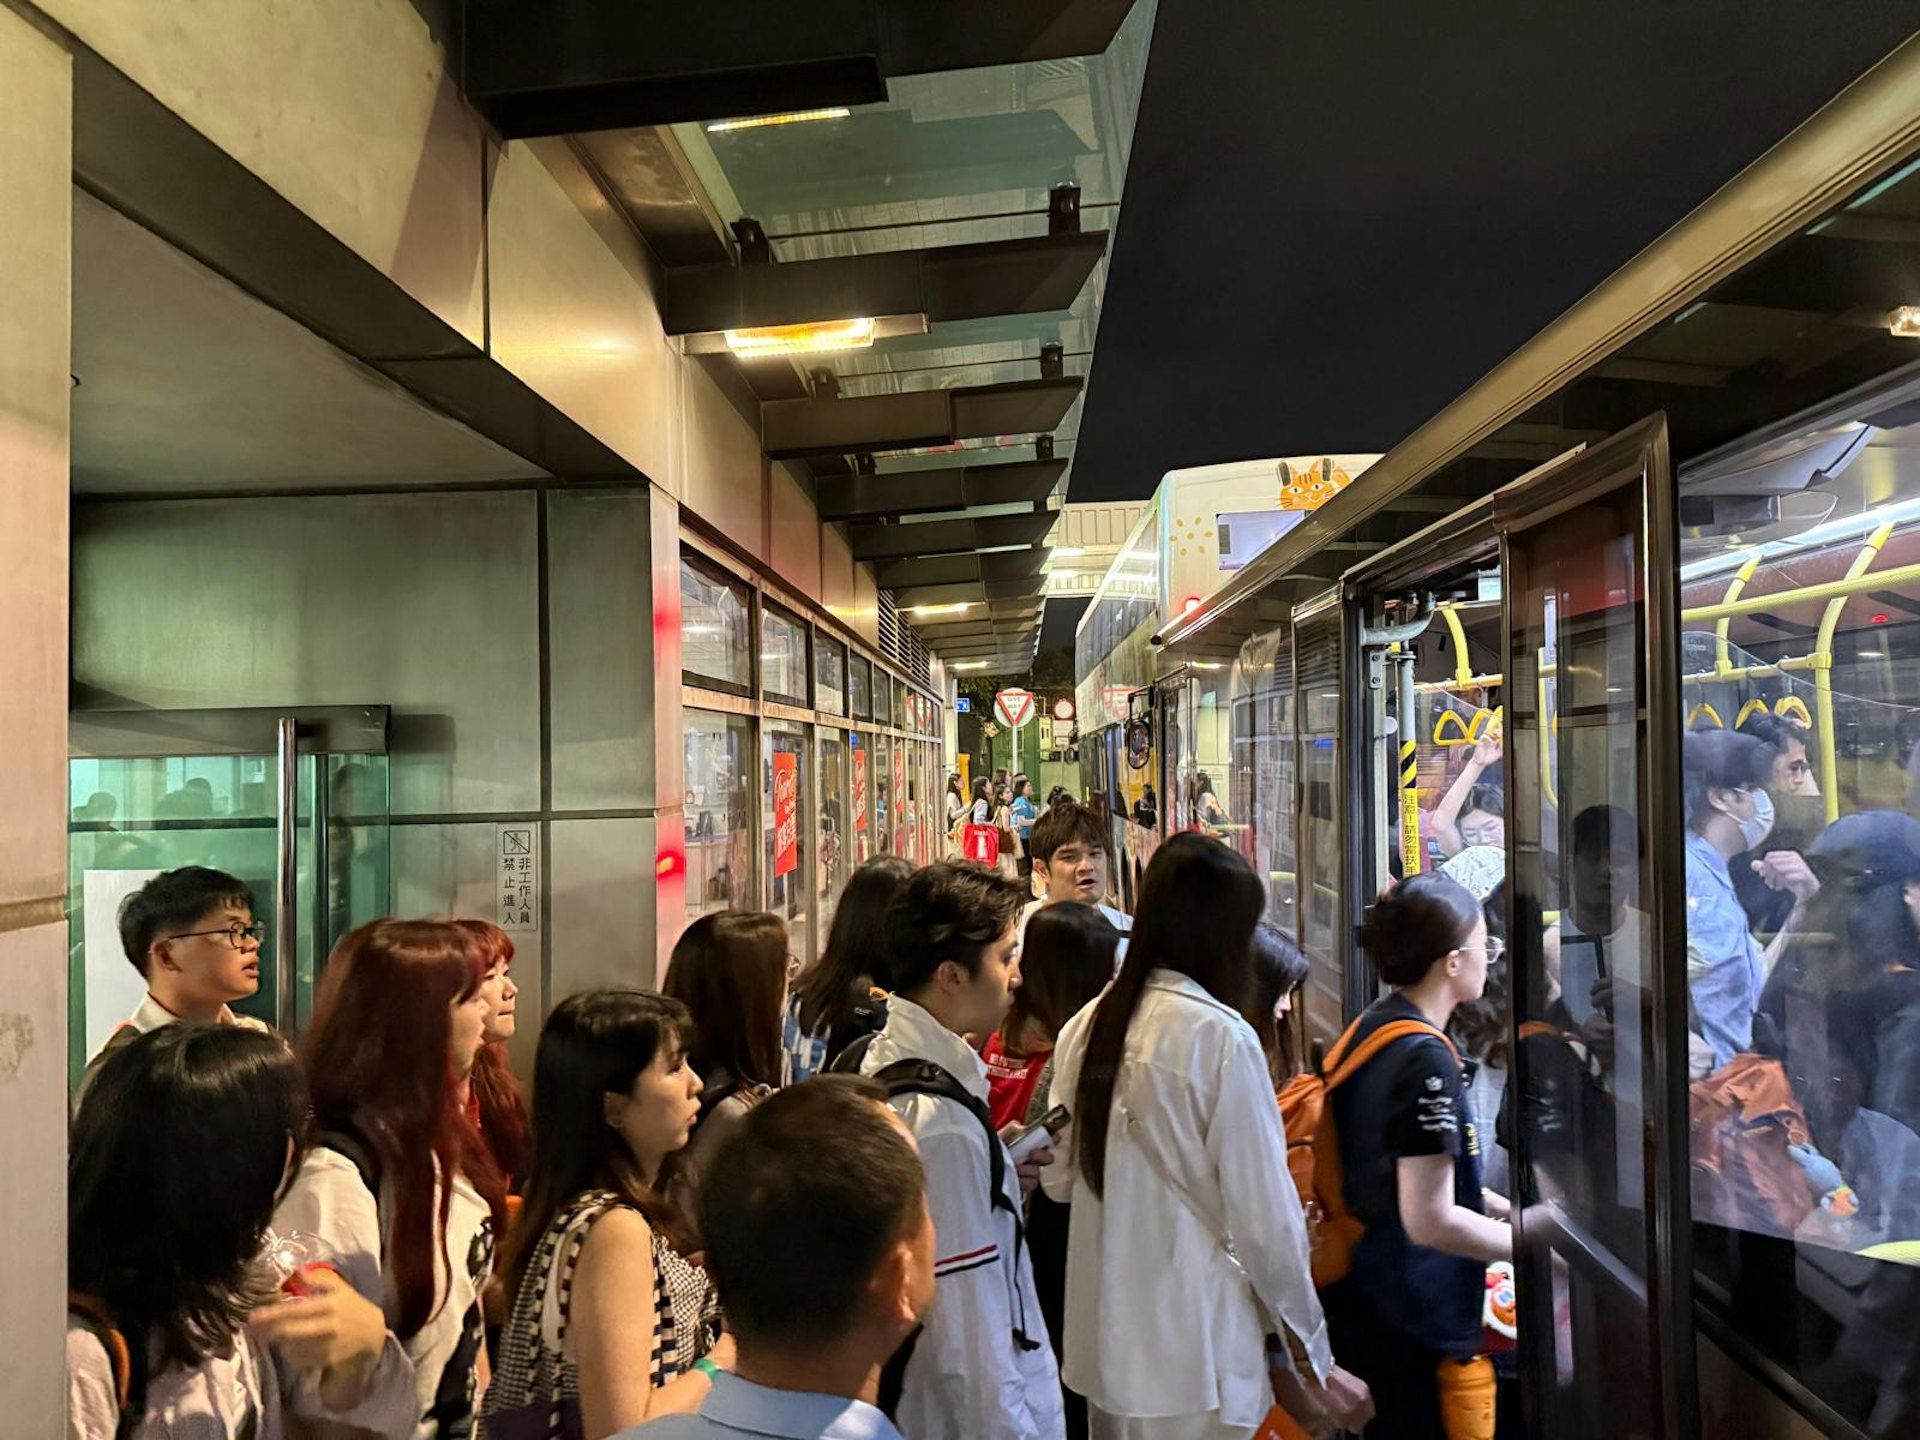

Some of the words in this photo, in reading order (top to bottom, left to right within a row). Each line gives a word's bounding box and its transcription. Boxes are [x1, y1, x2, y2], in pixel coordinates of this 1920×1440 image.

[503, 858, 516, 924] 禁止進入
[519, 856, 532, 924] 非工作人員
